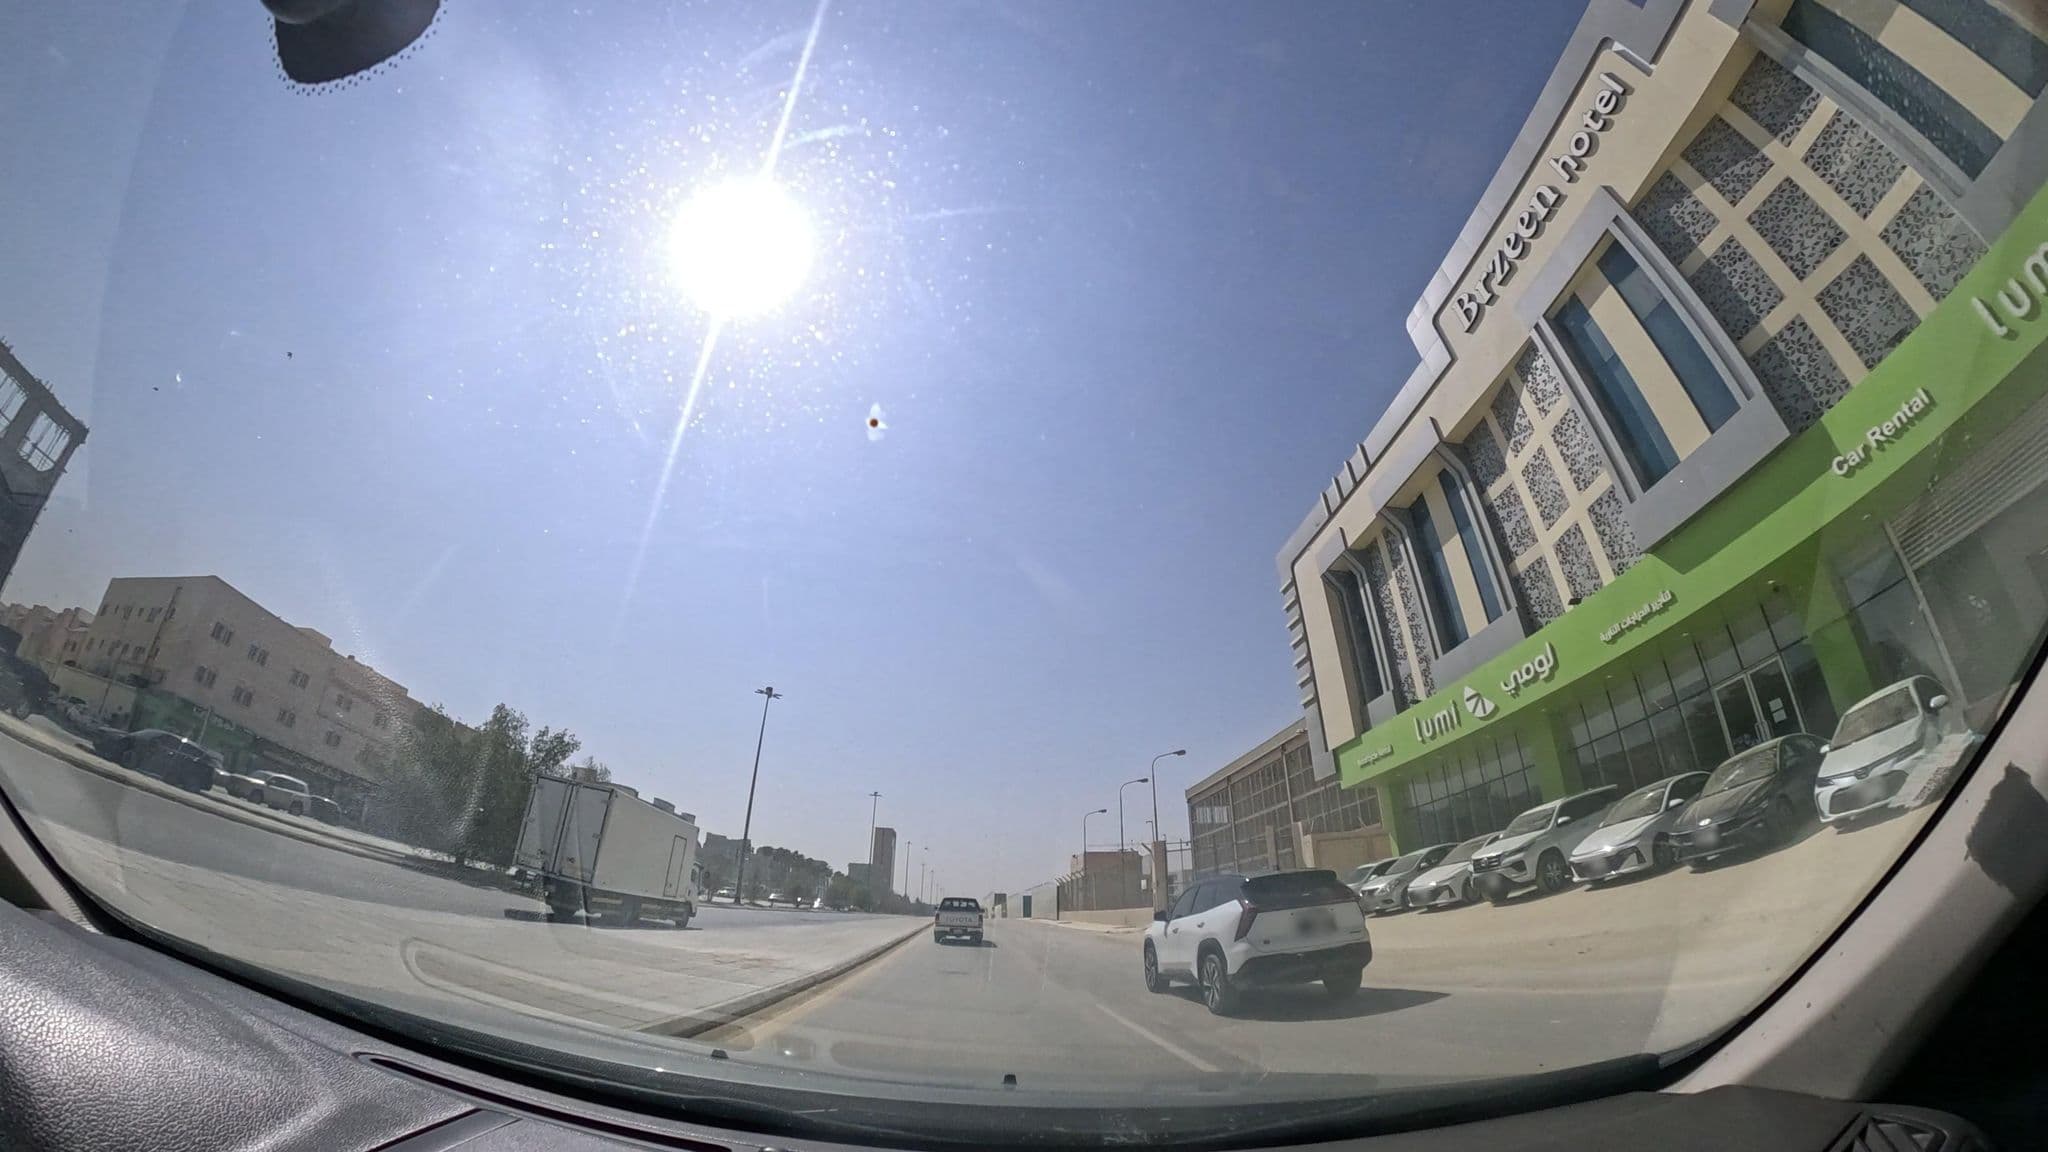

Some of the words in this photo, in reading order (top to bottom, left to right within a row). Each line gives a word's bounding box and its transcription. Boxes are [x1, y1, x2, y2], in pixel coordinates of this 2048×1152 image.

[1453, 185, 1561, 333] Brzeen
[1550, 72, 1626, 182] hotel
[1832, 444, 1865, 475] Car
[1867, 388, 1930, 448] Rental
[1500, 641, 1554, 695] لومي
[1414, 699, 1459, 742] lumi
